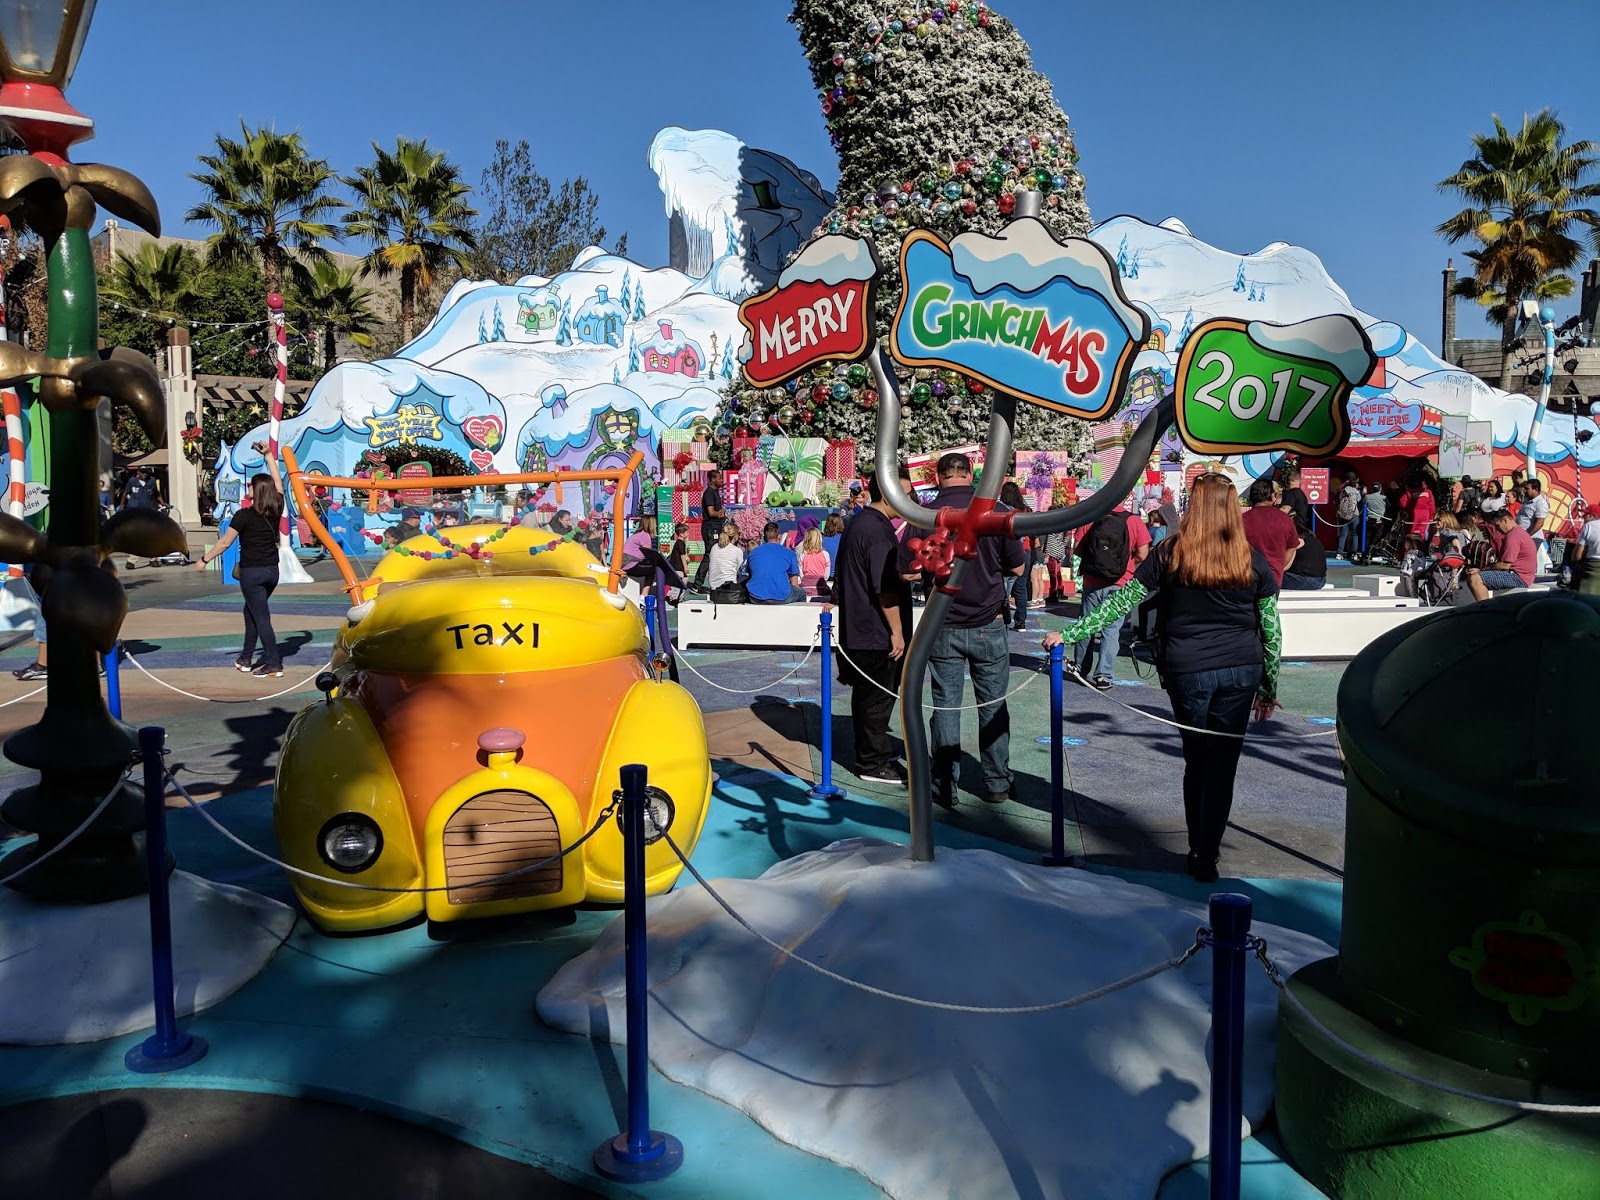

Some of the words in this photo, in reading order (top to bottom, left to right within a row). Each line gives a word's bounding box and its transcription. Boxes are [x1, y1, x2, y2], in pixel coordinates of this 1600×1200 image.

[759, 288, 857, 365] MERRY
[1193, 351, 1331, 431] 2017
[1360, 404, 1394, 415] MEET
[1378, 414, 1410, 425] HERE
[376, 427, 403, 441] POST
[405, 426, 435, 438] OFFICE
